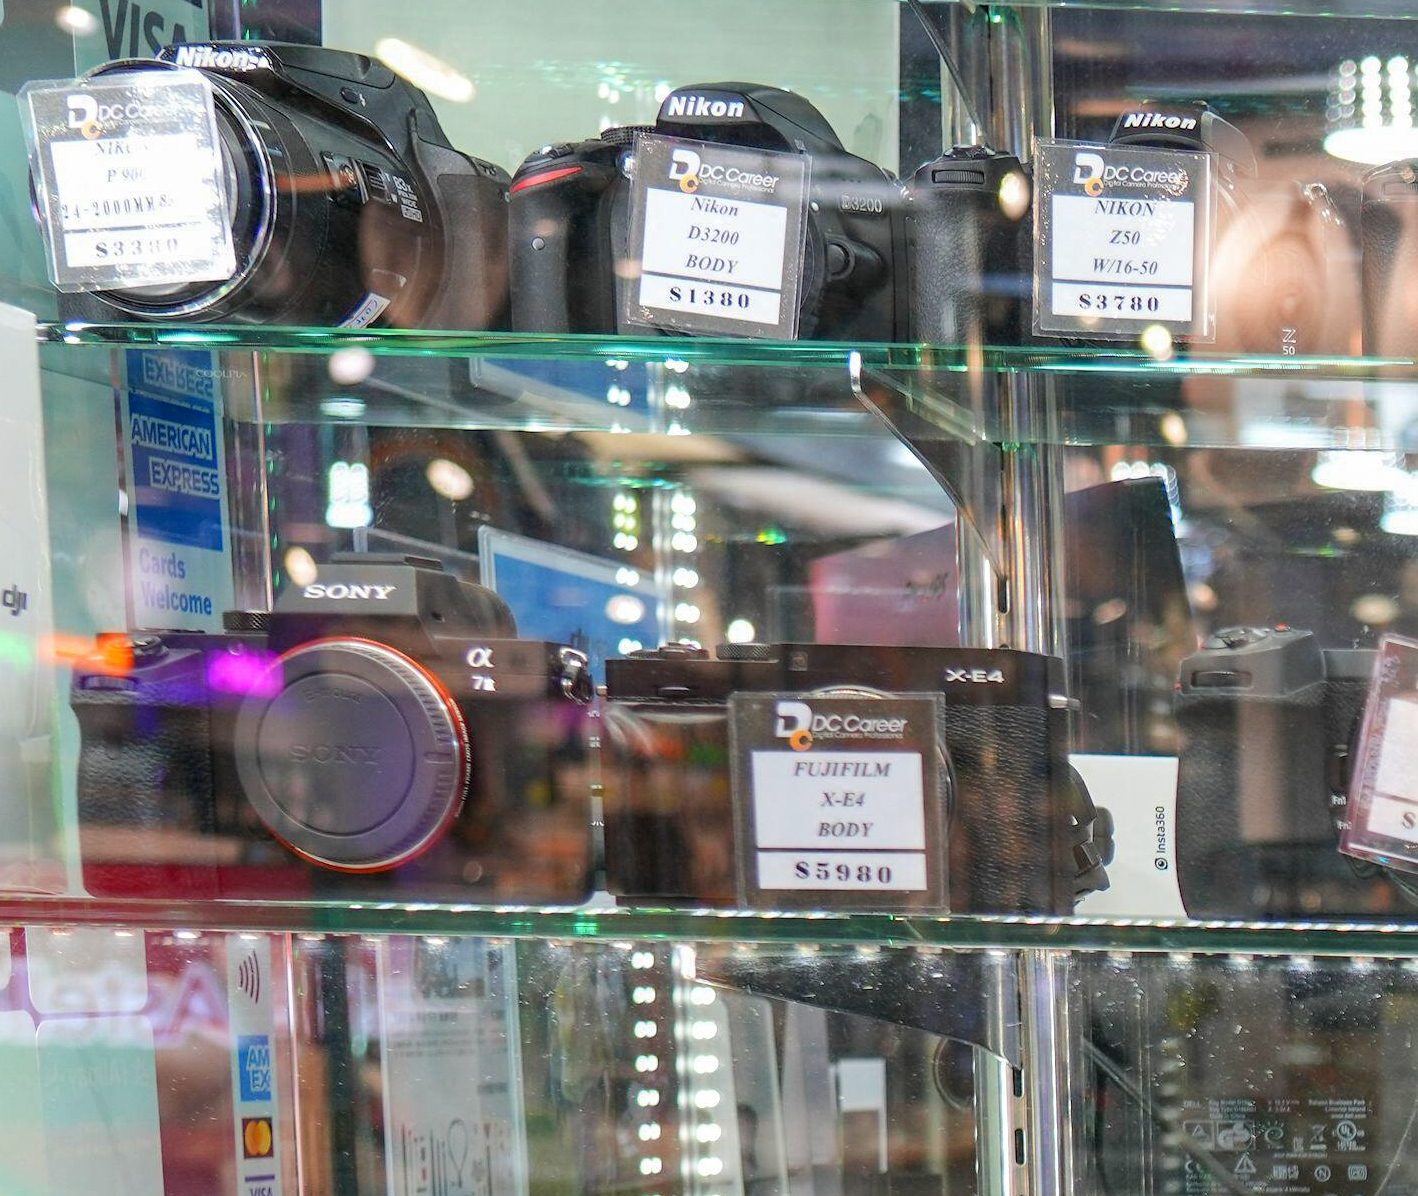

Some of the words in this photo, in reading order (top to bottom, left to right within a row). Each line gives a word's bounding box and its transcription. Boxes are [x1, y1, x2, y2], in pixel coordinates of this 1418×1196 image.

[668, 96, 745, 118] Nikon
[1124, 113, 1197, 131] Nikon
[725, 167, 780, 189] Career
[690, 197, 739, 217] Nikon
[1094, 199, 1156, 217] NIKON
[687, 225, 740, 246] D3200
[1109, 230, 1142, 246] Z50
[685, 254, 739, 274] BODY
[1093, 257, 1158, 276] W/16-50
[1282, 345, 1296, 356] 50
[131, 416, 213, 457] AMERICAN
[150, 460, 221, 495] EXPRESS
[139, 547, 187, 580] Cards
[140, 580, 213, 616] Welcome
[303, 584, 397, 601] SONY
[945, 667, 1005, 684] X-E4
[841, 715, 908, 734] Career
[794, 761, 892, 778] FUJIFILM
[819, 791, 867, 809] X-E4
[818, 820, 873, 839] BODY
[1155, 805, 1167, 855] Insta360
